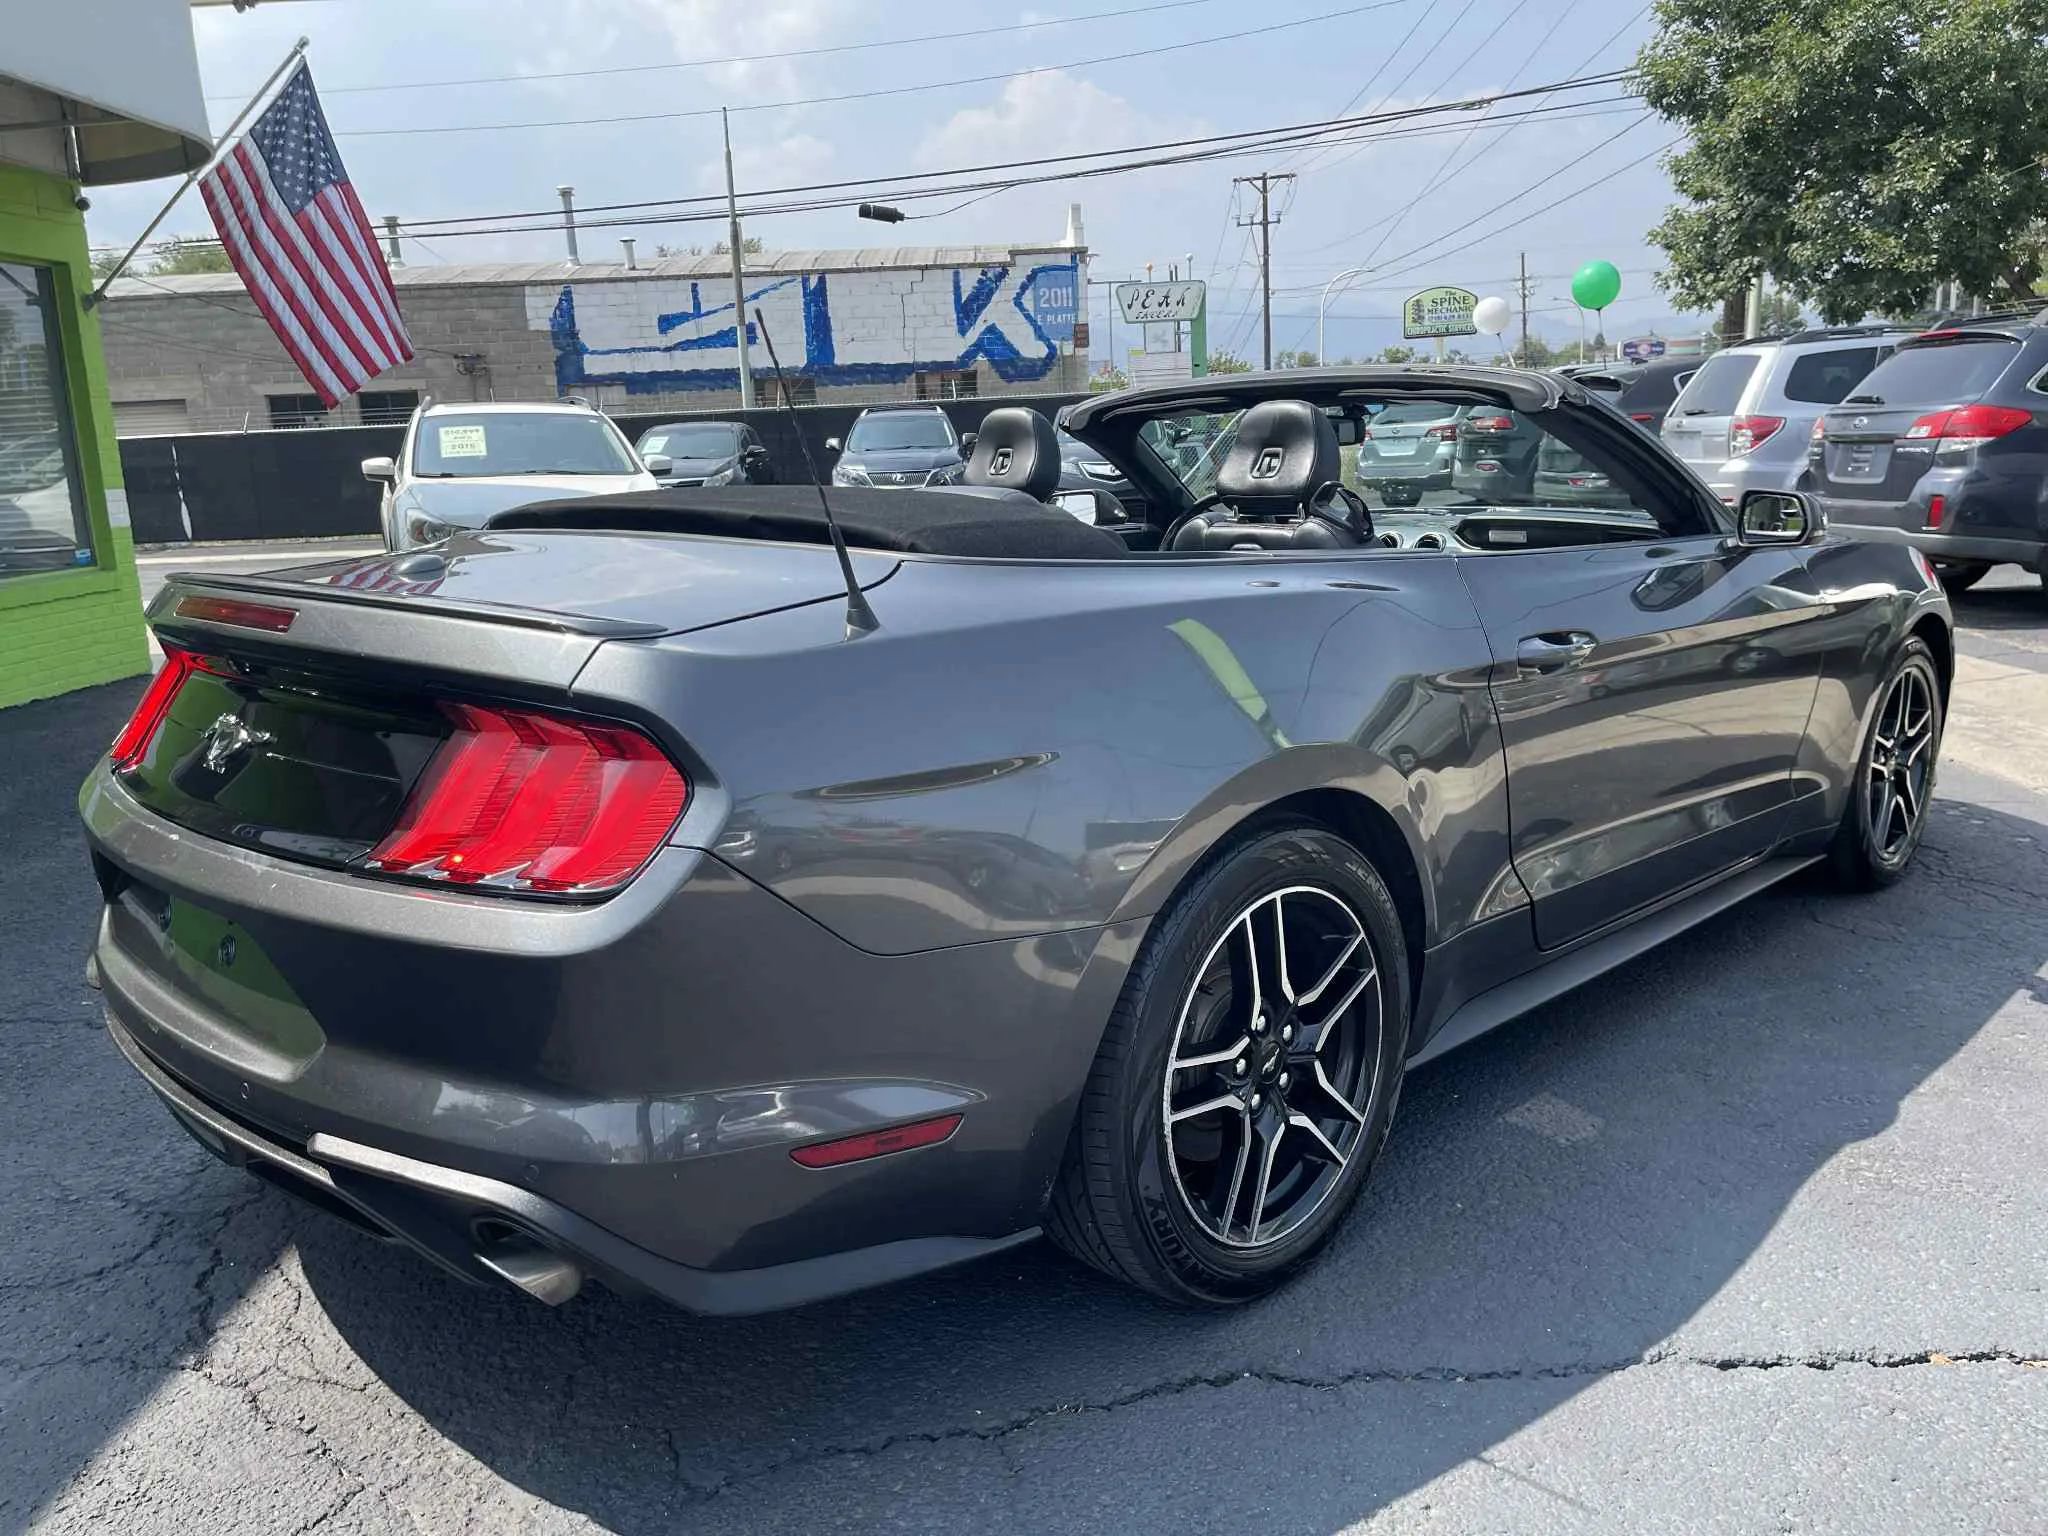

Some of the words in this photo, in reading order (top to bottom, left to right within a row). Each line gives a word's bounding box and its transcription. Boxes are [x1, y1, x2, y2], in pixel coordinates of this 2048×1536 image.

[1039, 287, 1073, 308] 2011
[1127, 287, 1191, 310] PEAK
[1431, 295, 1470, 308] SPINE
[1427, 304, 1474, 315] MECHANIC
